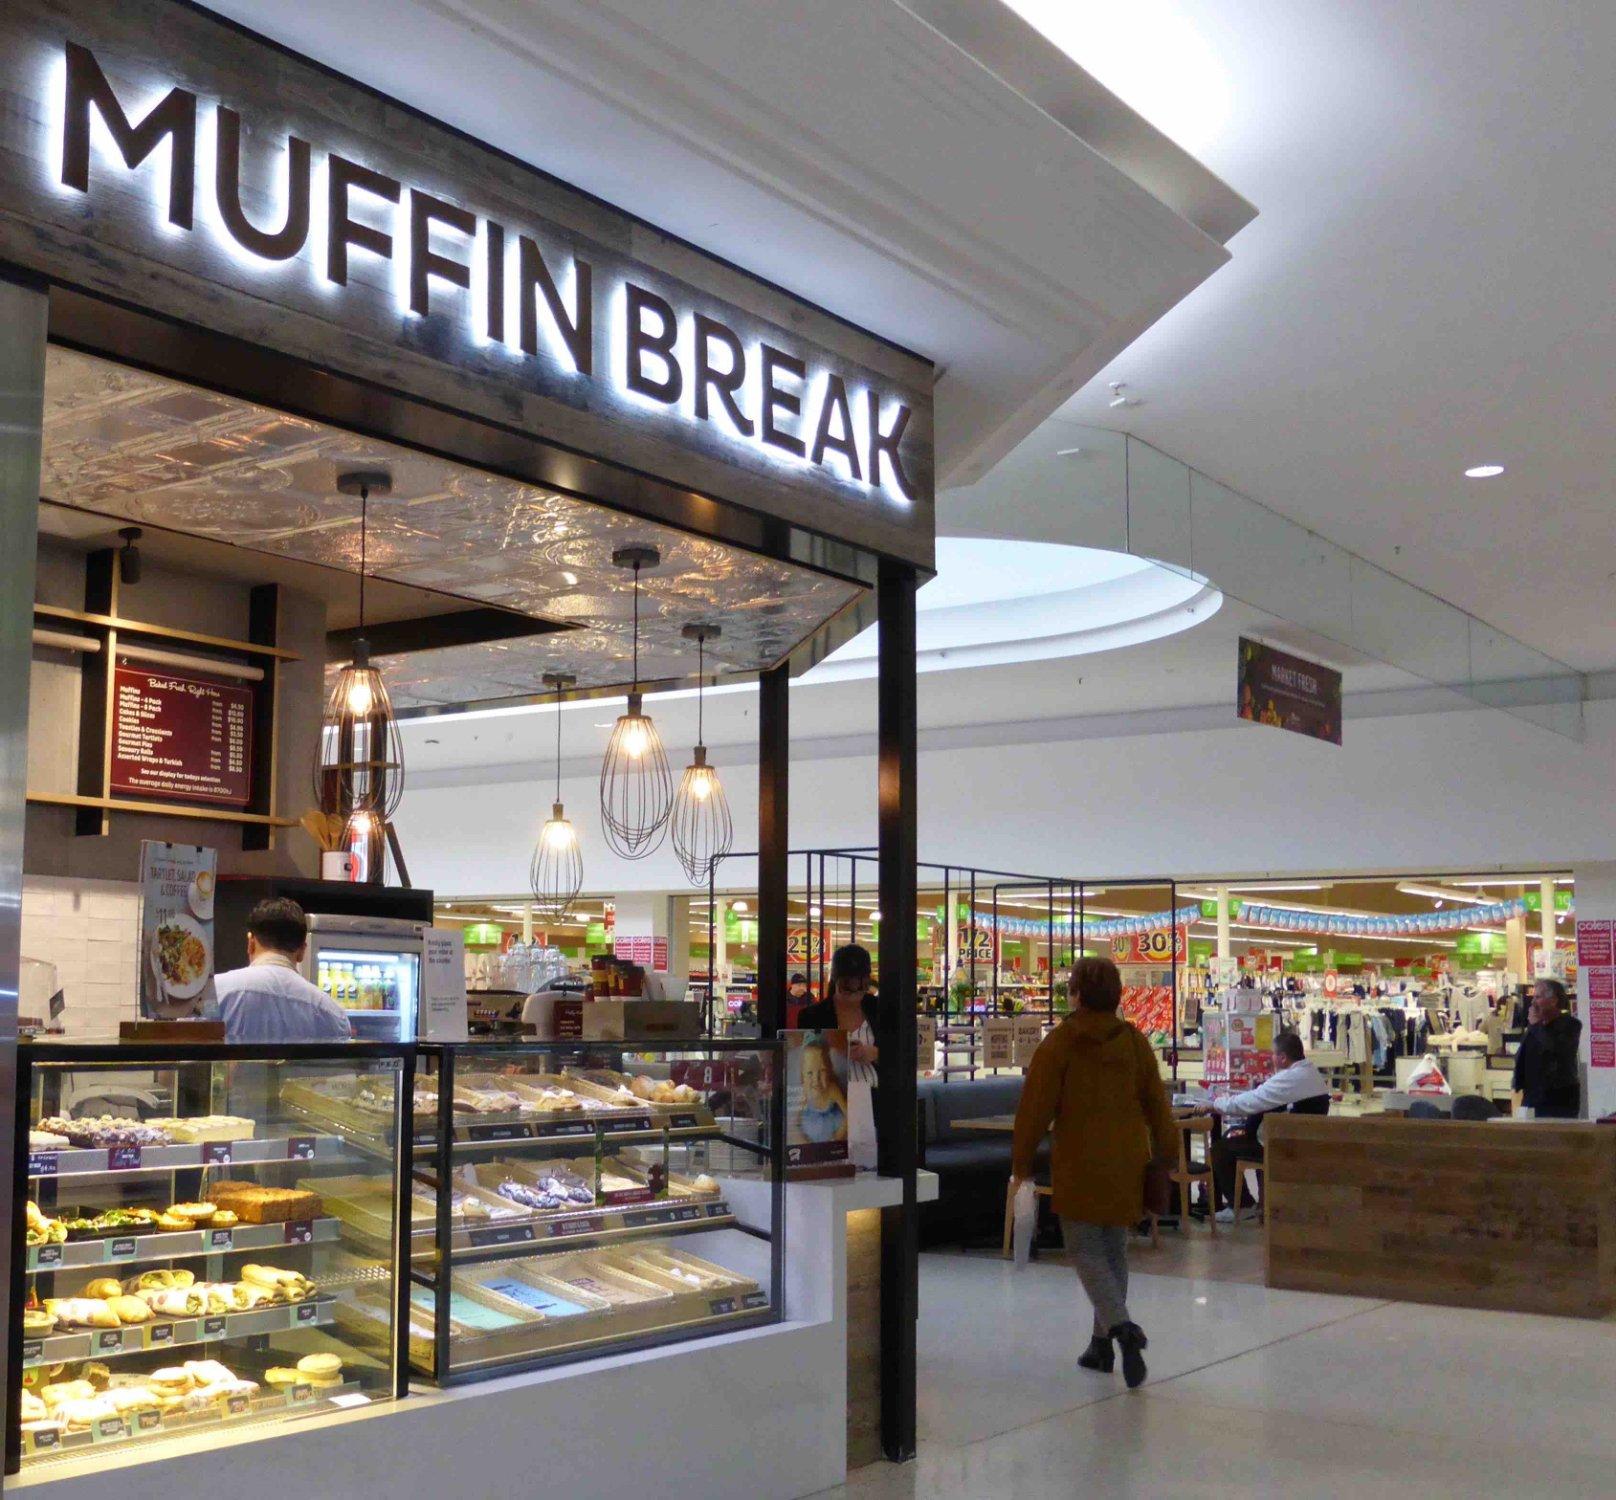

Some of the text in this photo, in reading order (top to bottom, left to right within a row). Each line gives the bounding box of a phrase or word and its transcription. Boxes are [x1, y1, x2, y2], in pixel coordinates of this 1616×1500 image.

[61, 40, 917, 501] MUFFIN BREAK
[120, 686, 140, 694] Muffins
[120, 694, 140, 702] Muffins
[120, 701, 140, 709] Muffins
[119, 708, 135, 716] Cakes
[141, 711, 155, 719] Slices
[119, 716, 139, 724] Cookies
[119, 723, 140, 732] Toasties
[146, 727, 172, 736] Croissants
[119, 731, 141, 739] Gourmet
[119, 738, 141, 746] Gourmet
[118, 745, 140, 754] Savoury
[118, 753, 140, 761] Assorted
[142, 756, 158, 764] Wraps
[164, 758, 182, 766] Turkish
[139, 779, 160, 787] average
[161, 781, 174, 789] daily
[1579, 921, 1611, 931] coles
[958, 948, 993, 959] PRICE
